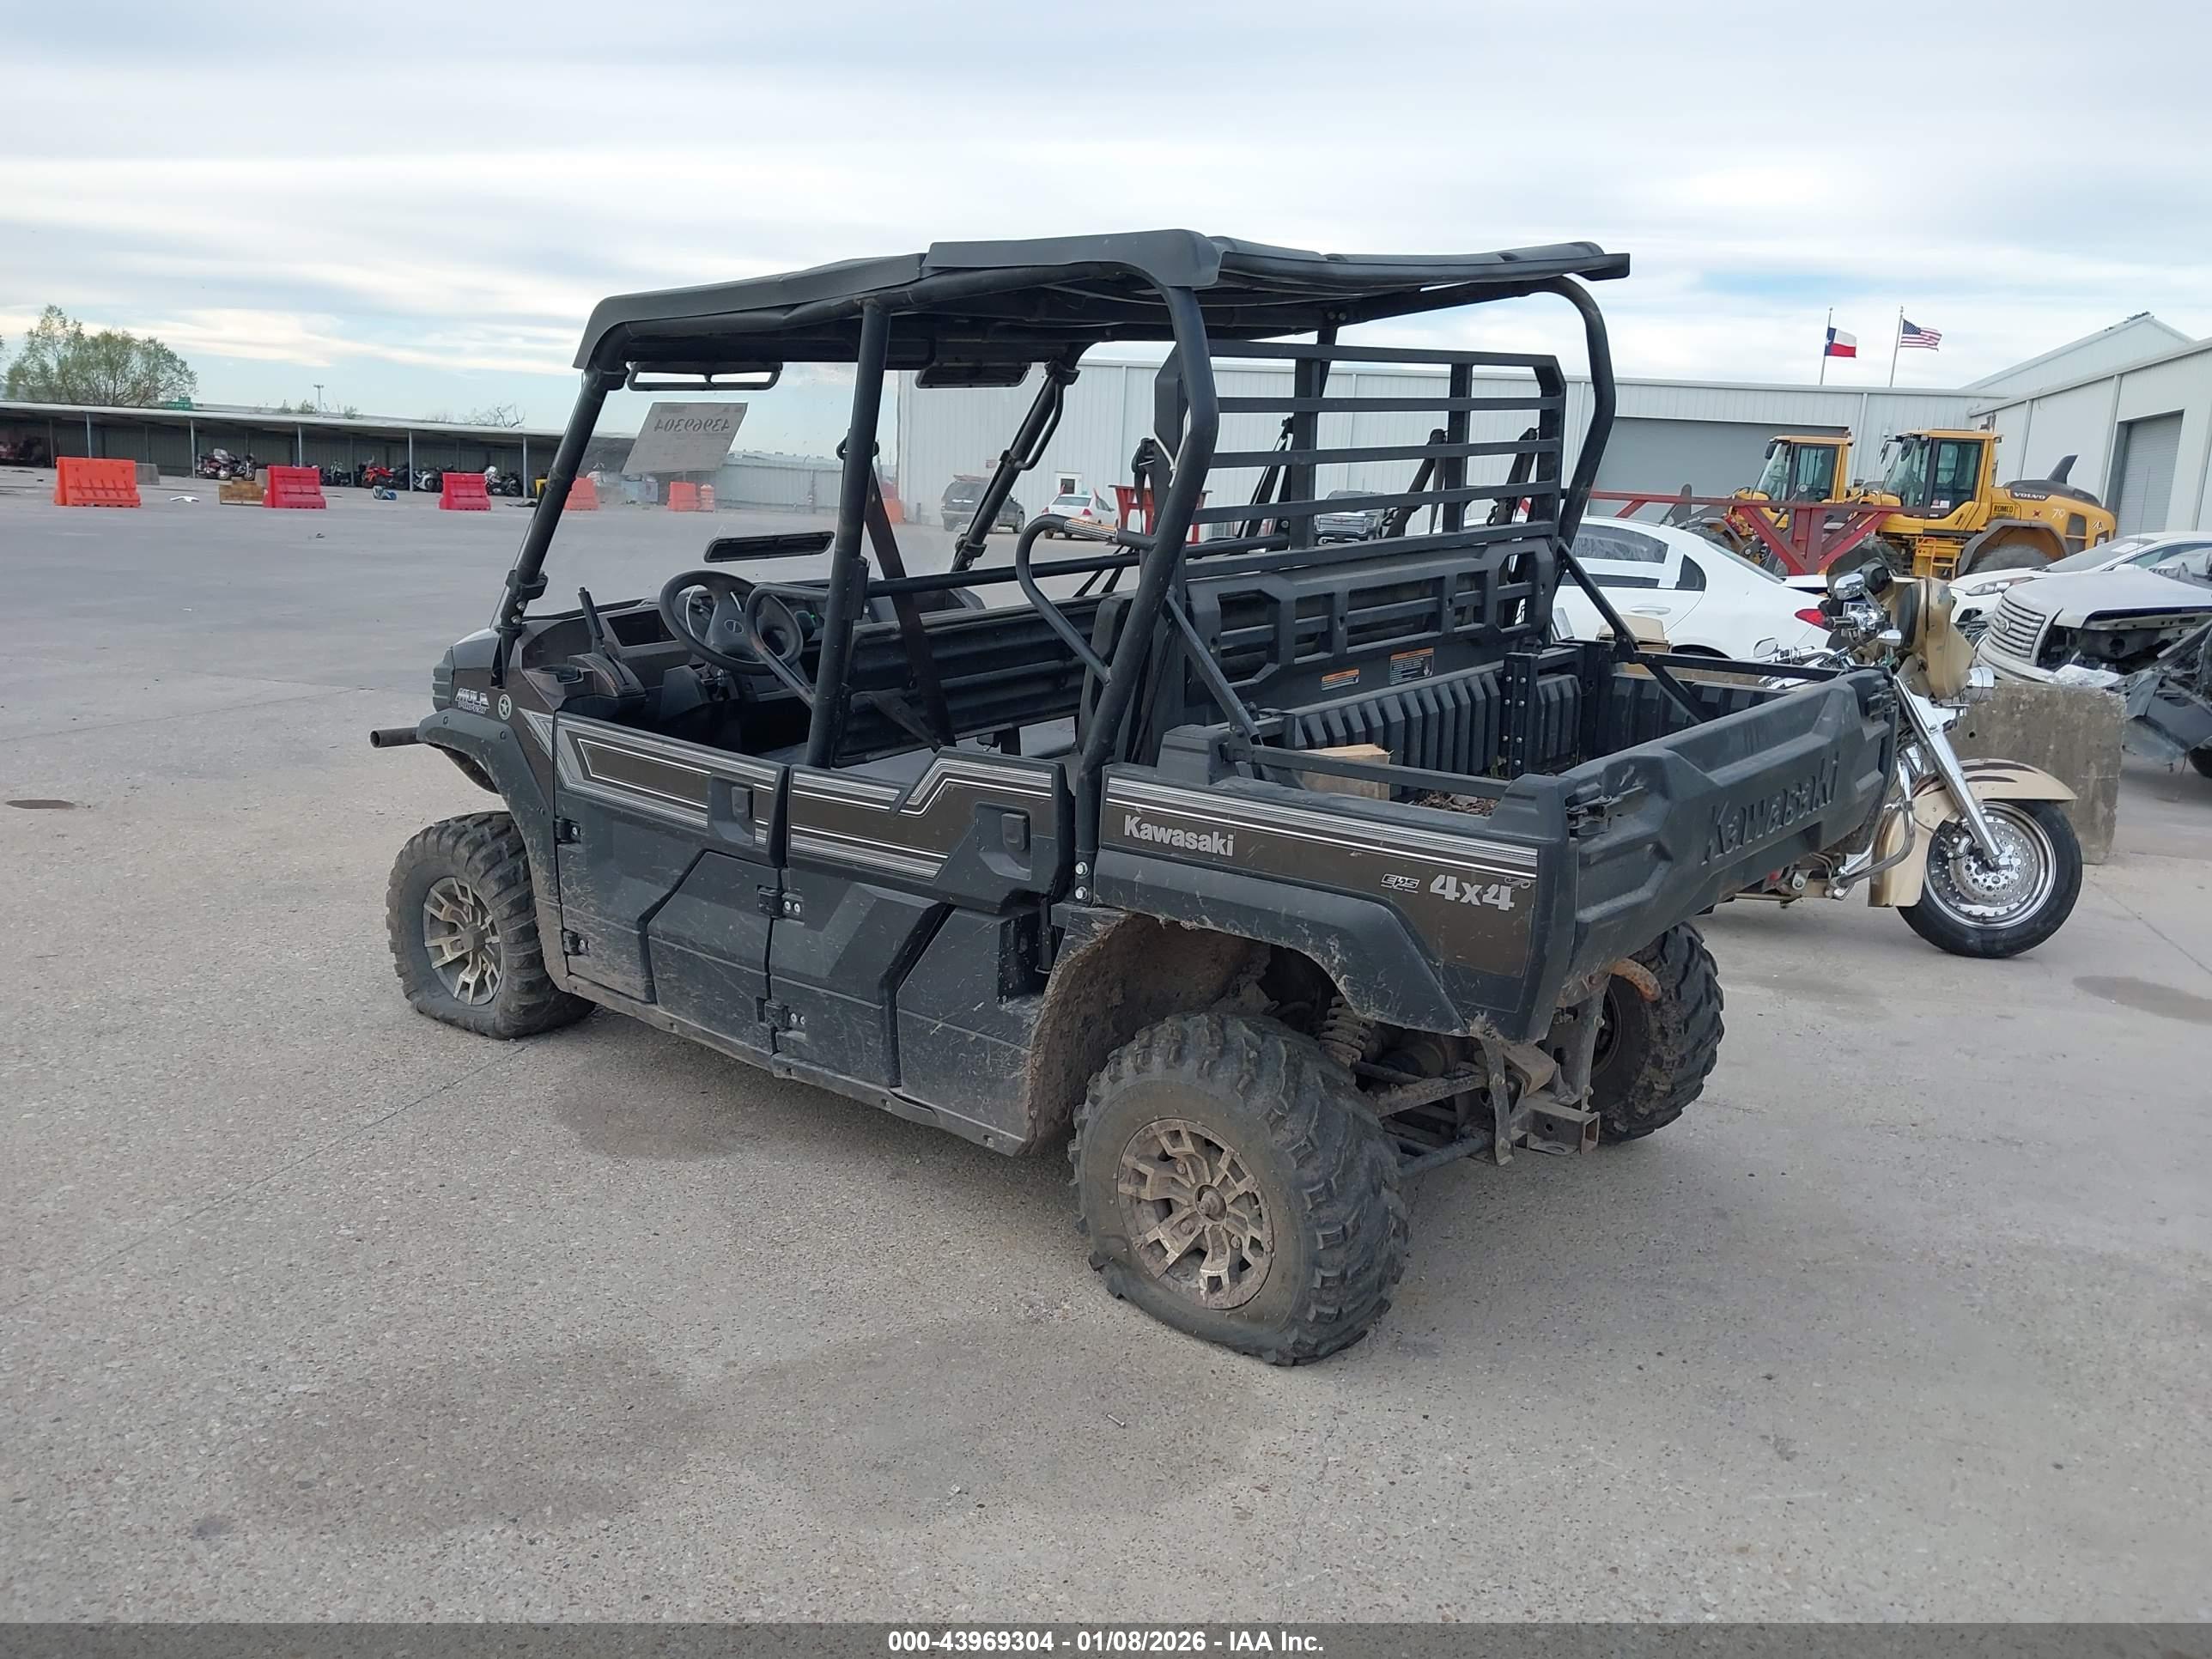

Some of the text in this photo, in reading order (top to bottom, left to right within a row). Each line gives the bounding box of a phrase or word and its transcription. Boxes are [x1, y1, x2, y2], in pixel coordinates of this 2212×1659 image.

[1993, 504, 2014, 514] ROMCO
[2013, 491, 2046, 500] VOLVO
[454, 688, 490, 708] MULE
[1701, 752, 1839, 866] Kawasaki
[1124, 815, 1234, 857] Kawasaki
[1430, 874, 1515, 911] 4x4
